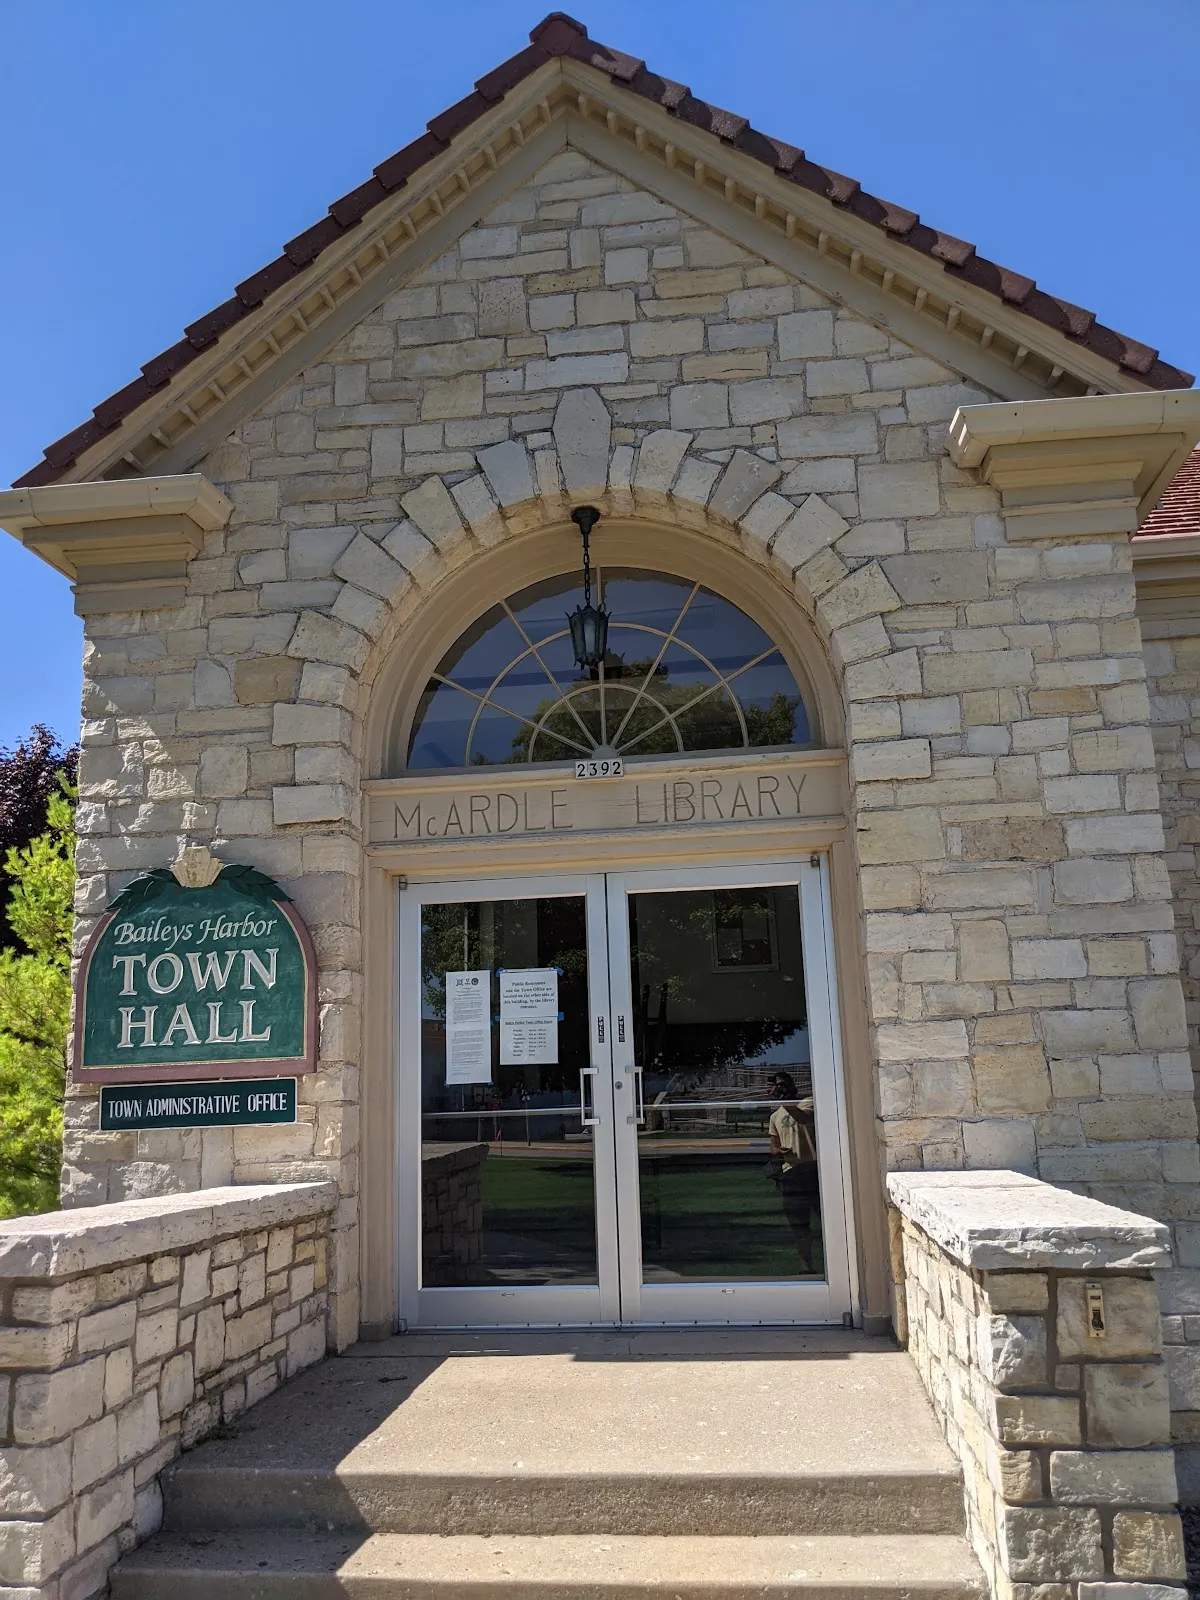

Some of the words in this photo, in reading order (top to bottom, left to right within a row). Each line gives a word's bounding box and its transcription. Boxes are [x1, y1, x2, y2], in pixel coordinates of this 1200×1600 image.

[577, 761, 621, 777] 2392
[393, 789, 573, 839] McARDLE
[635, 774, 807, 824] LIBRARY
[114, 916, 194, 951] Baileys
[196, 911, 278, 945] Harbor
[112, 949, 280, 996] TOWN
[117, 1000, 271, 1048] HALL
[108, 1099, 142, 1118] TOWN
[145, 1094, 241, 1117] ADMINISTRATIVE
[247, 1092, 288, 1112] OFFICE
